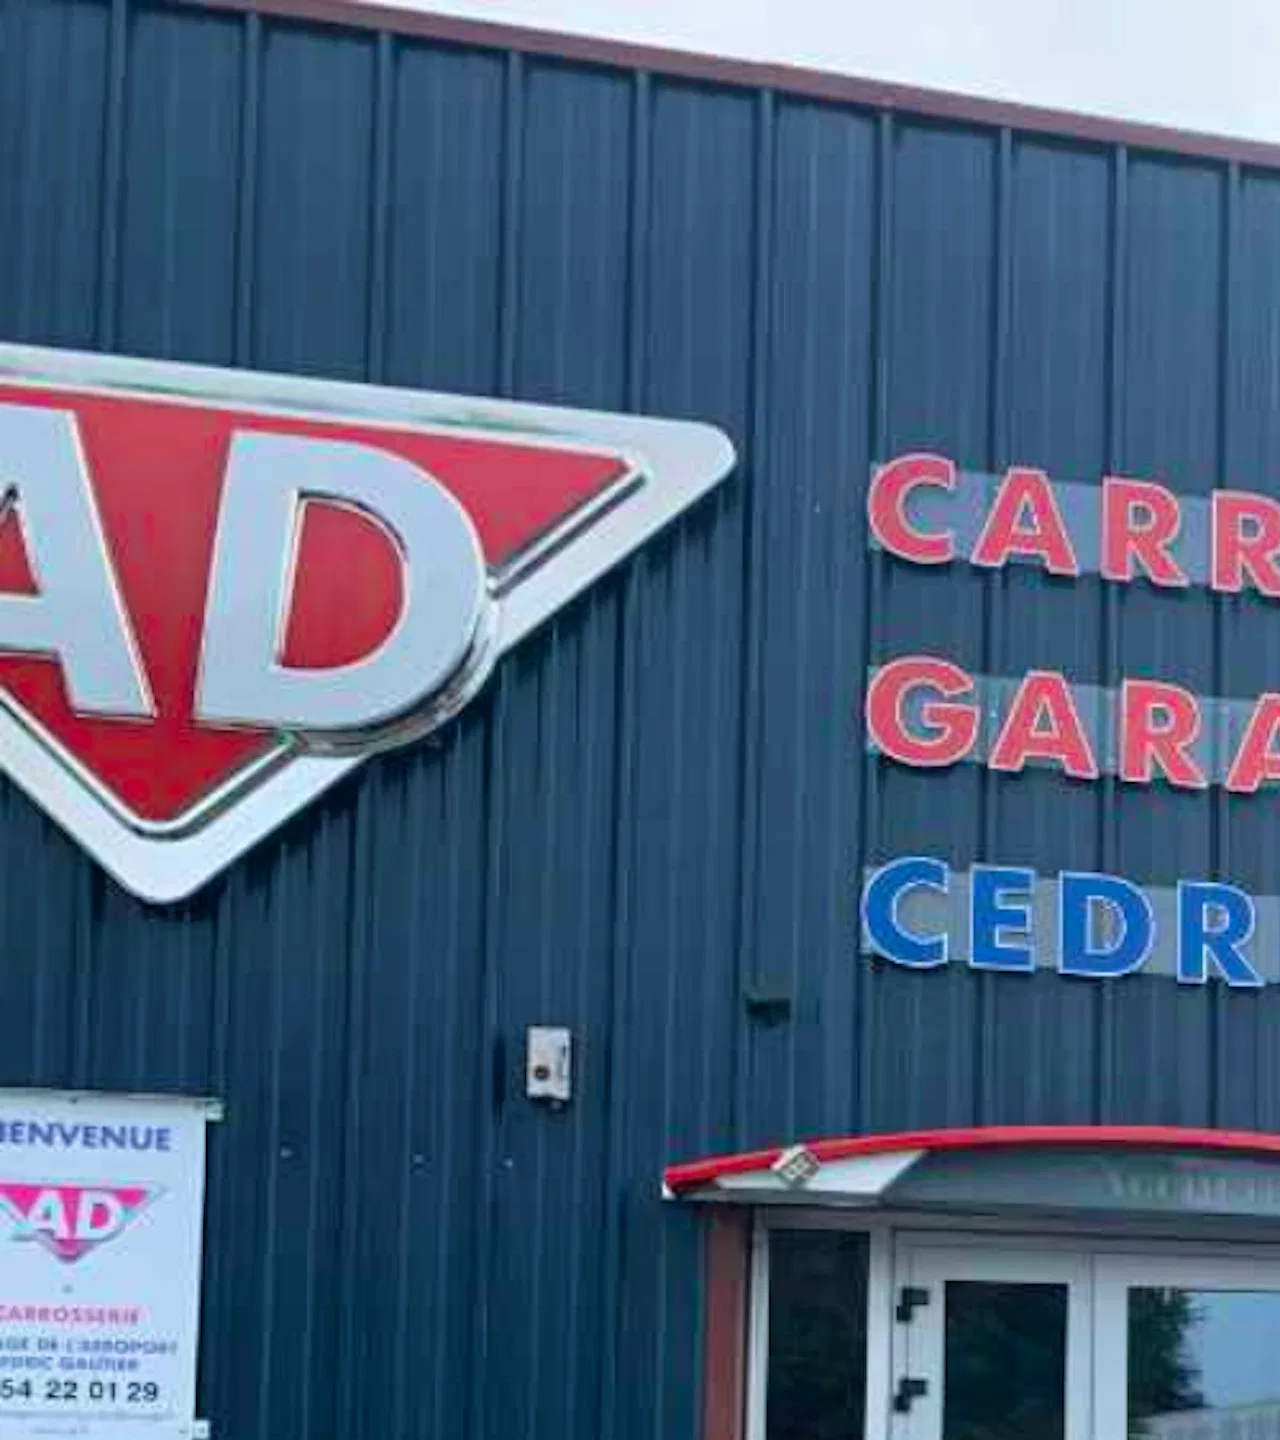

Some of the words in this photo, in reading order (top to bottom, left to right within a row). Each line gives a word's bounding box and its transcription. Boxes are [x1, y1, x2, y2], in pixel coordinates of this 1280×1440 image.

[26, 1188, 121, 1240] AD
[1, 1378, 32, 1399] 54
[46, 1380, 78, 1400] 22
[89, 1381, 116, 1402] 01
[128, 1381, 159, 1403] 29
